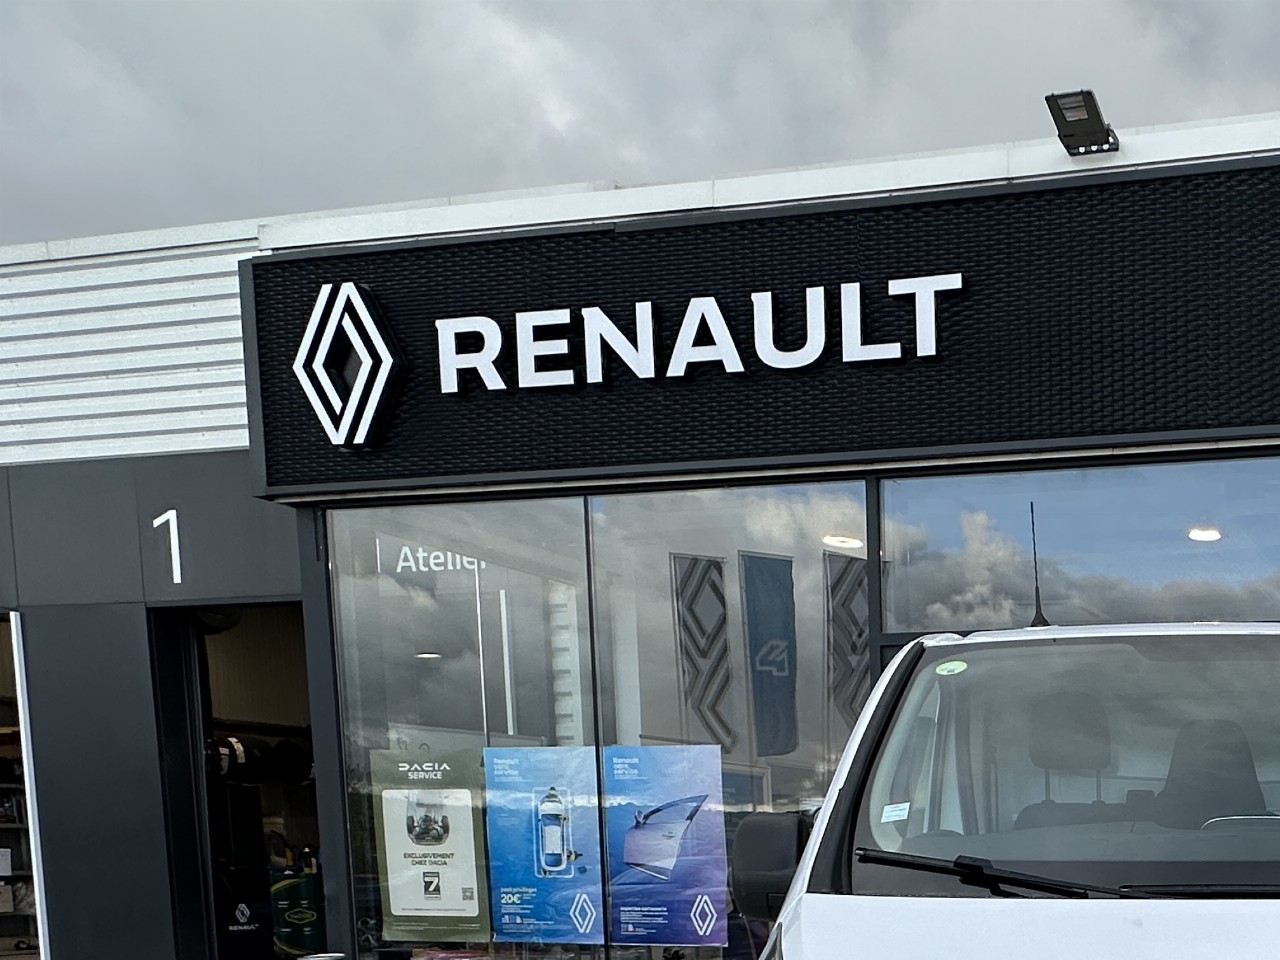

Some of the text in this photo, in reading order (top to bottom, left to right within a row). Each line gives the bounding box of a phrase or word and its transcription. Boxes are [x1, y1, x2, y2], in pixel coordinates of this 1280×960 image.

[435, 272, 962, 394] RENAULT
[153, 509, 182, 584] 1
[398, 762, 451, 771] DACIA
[408, 771, 443, 779] SERVICE
[424, 876, 439, 891] 7
